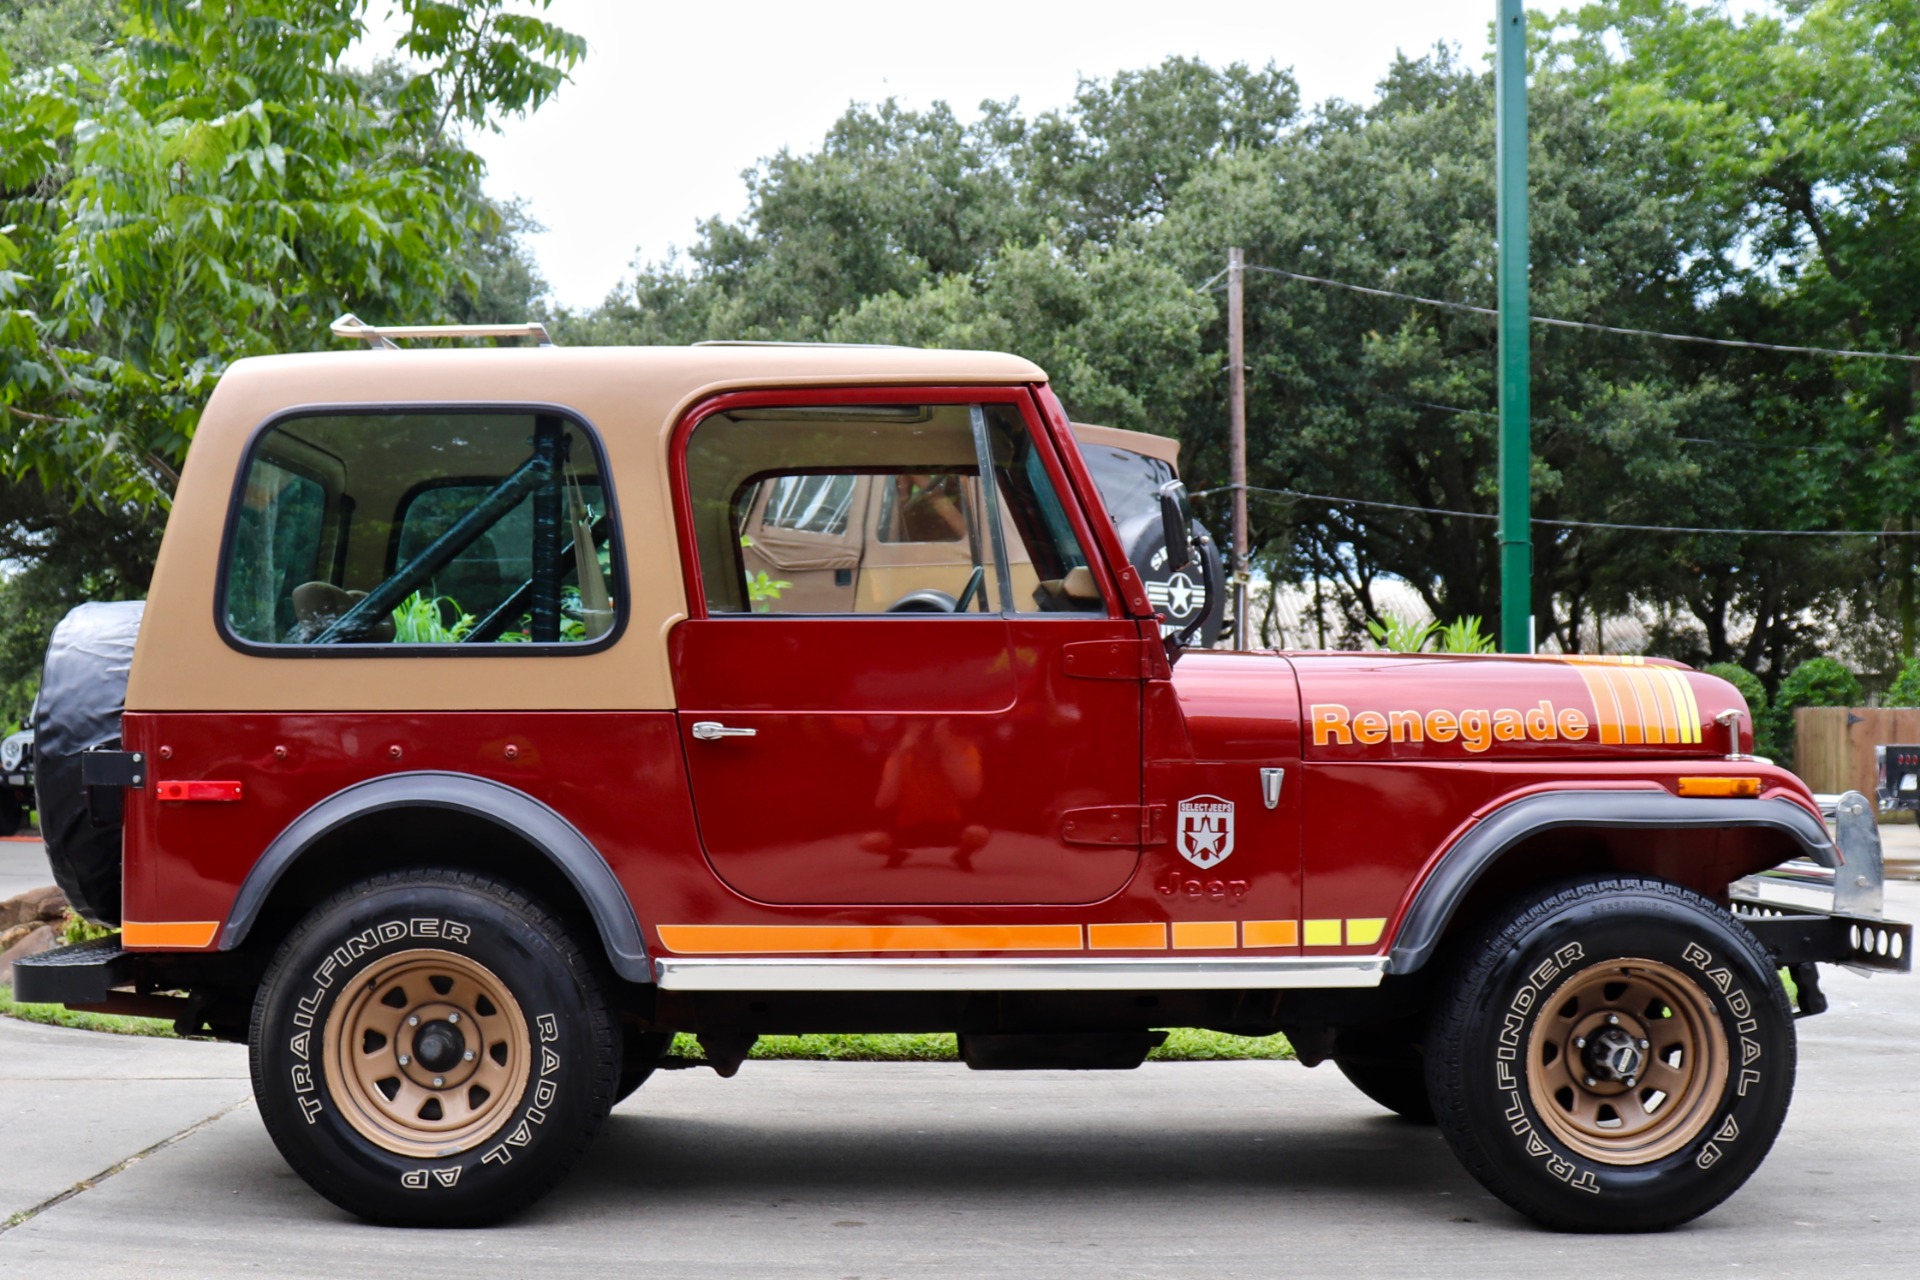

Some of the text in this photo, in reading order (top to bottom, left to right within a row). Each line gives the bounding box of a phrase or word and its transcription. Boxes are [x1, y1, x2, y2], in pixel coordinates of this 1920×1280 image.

[1310, 700, 1589, 752] Renegade
[1159, 872, 1249, 907] Jeep
[290, 918, 471, 1124] TRAILFINDER
[1497, 941, 1761, 1194] TRAILFINDER RADIAL AP
[481, 1013, 560, 1165] RADIAL
[401, 1166, 462, 1189] AP
